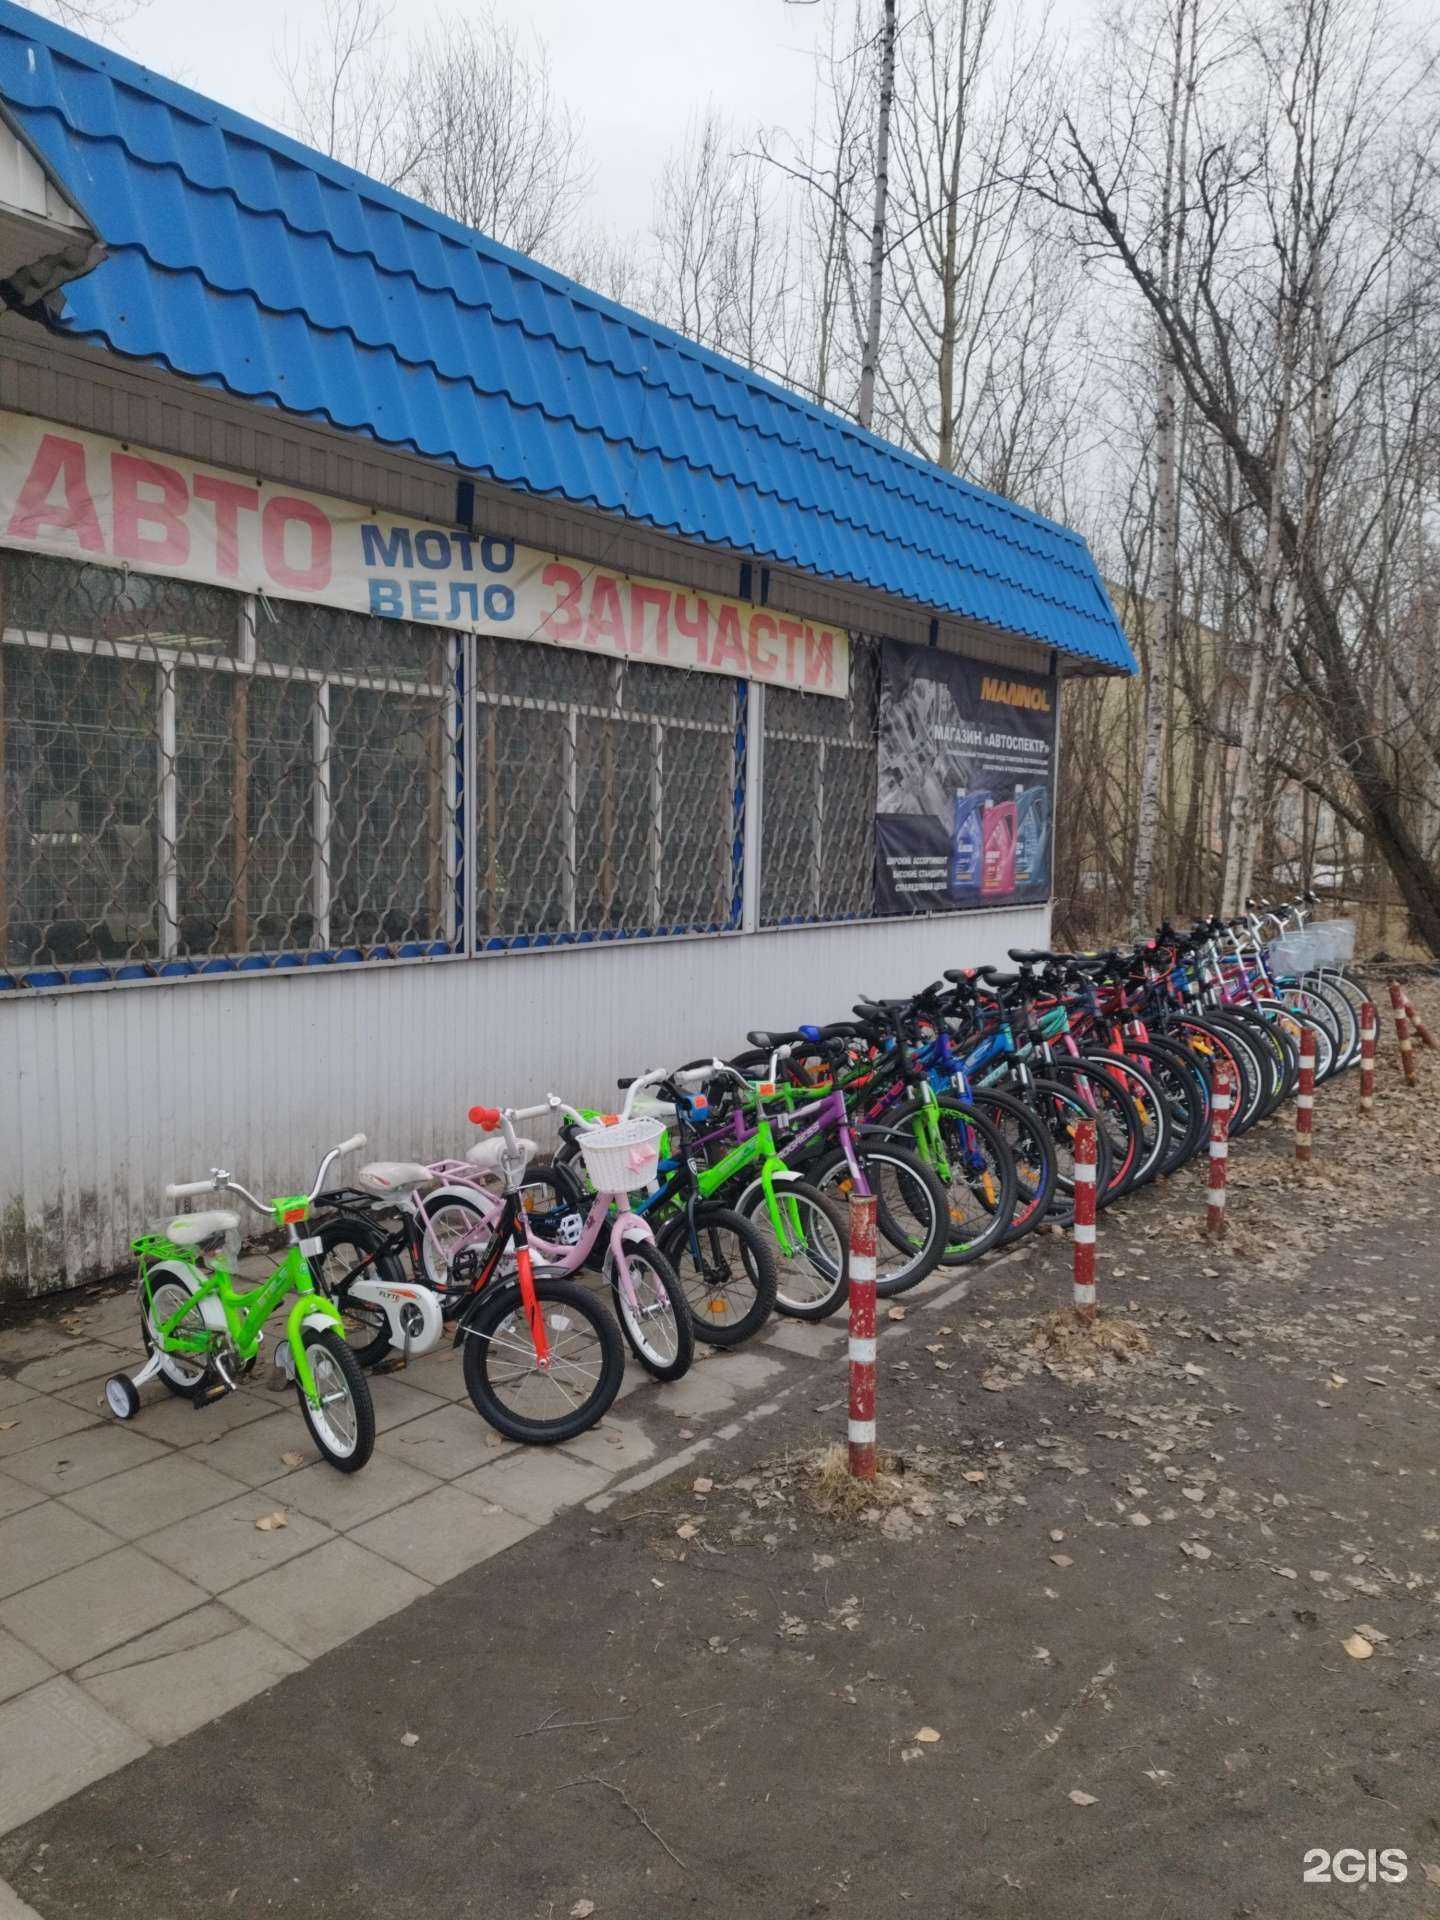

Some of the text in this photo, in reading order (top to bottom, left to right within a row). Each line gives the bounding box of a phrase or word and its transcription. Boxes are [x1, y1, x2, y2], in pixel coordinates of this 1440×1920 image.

[8, 433, 333, 593] АВТО
[361, 523, 515, 573] МОТО
[368, 578, 515, 622] ВЕЛО
[539, 562, 834, 688] ЗАПЧАСТИ
[980, 676, 1050, 711] MANNOL
[934, 725, 982, 745] МАГАЗИН
